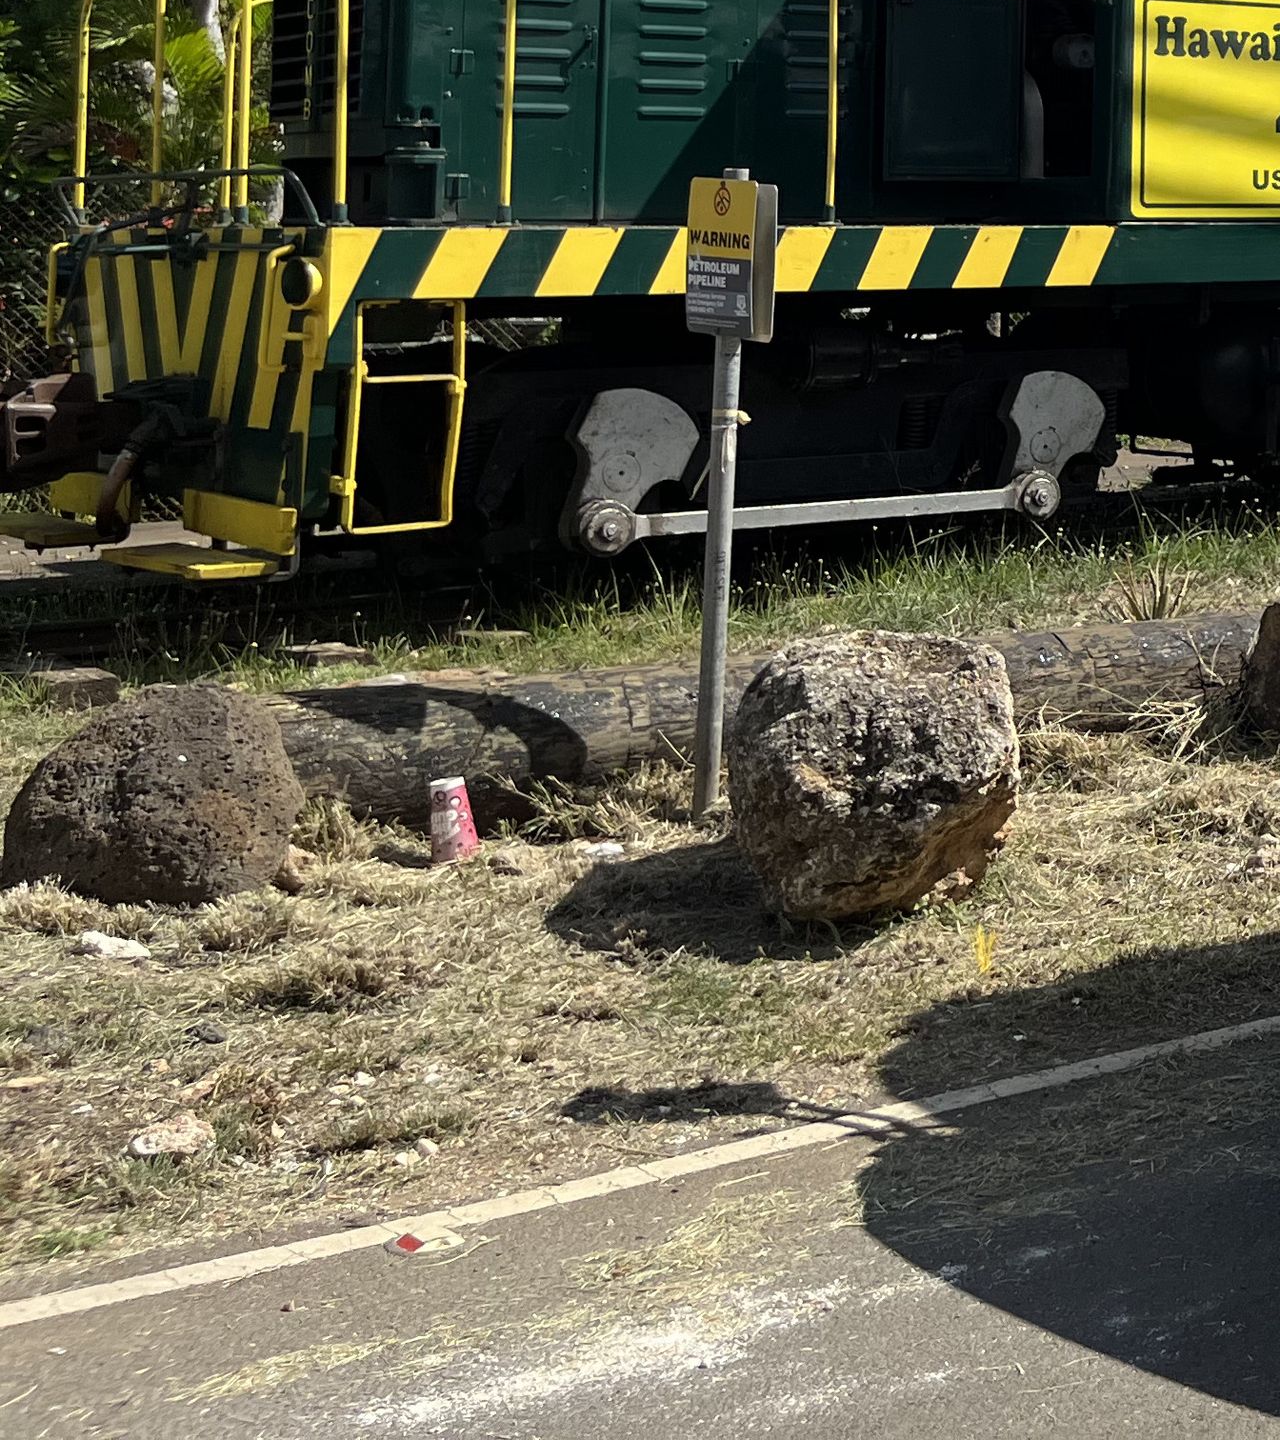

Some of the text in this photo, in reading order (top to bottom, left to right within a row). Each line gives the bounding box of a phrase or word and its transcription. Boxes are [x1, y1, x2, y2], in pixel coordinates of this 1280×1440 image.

[690, 229, 750, 250] WARNING
[688, 259, 740, 276] PETROLEUM
[688, 273, 727, 289] PIPELINE
